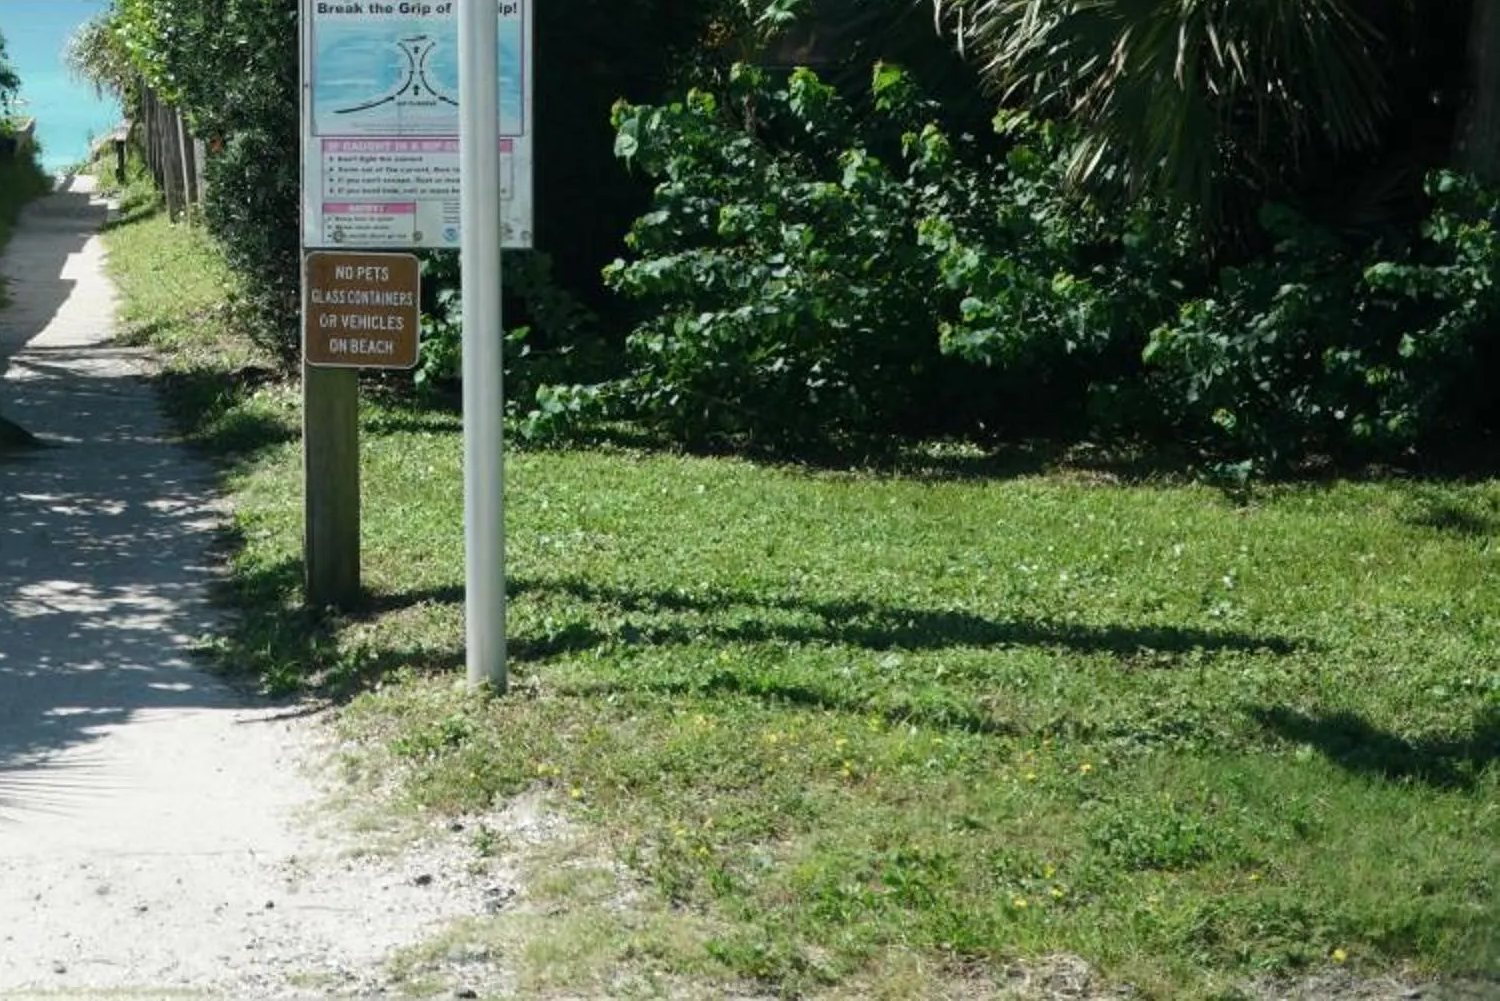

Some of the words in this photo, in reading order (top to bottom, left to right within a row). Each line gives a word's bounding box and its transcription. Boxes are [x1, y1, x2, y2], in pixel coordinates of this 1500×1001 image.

[317, 2, 363, 15] Break
[369, 2, 393, 15] the
[399, 2, 431, 17] Grip
[436, 2, 452, 15] of
[498, 2, 517, 16] ip!
[335, 265, 353, 281] NO
[357, 265, 389, 281] PETS
[347, 290, 413, 306] CONTAINERS
[319, 313, 337, 328] OR
[341, 314, 405, 330] VEHICLES
[329, 338, 348, 354] ON
[350, 338, 393, 354] BEACH
